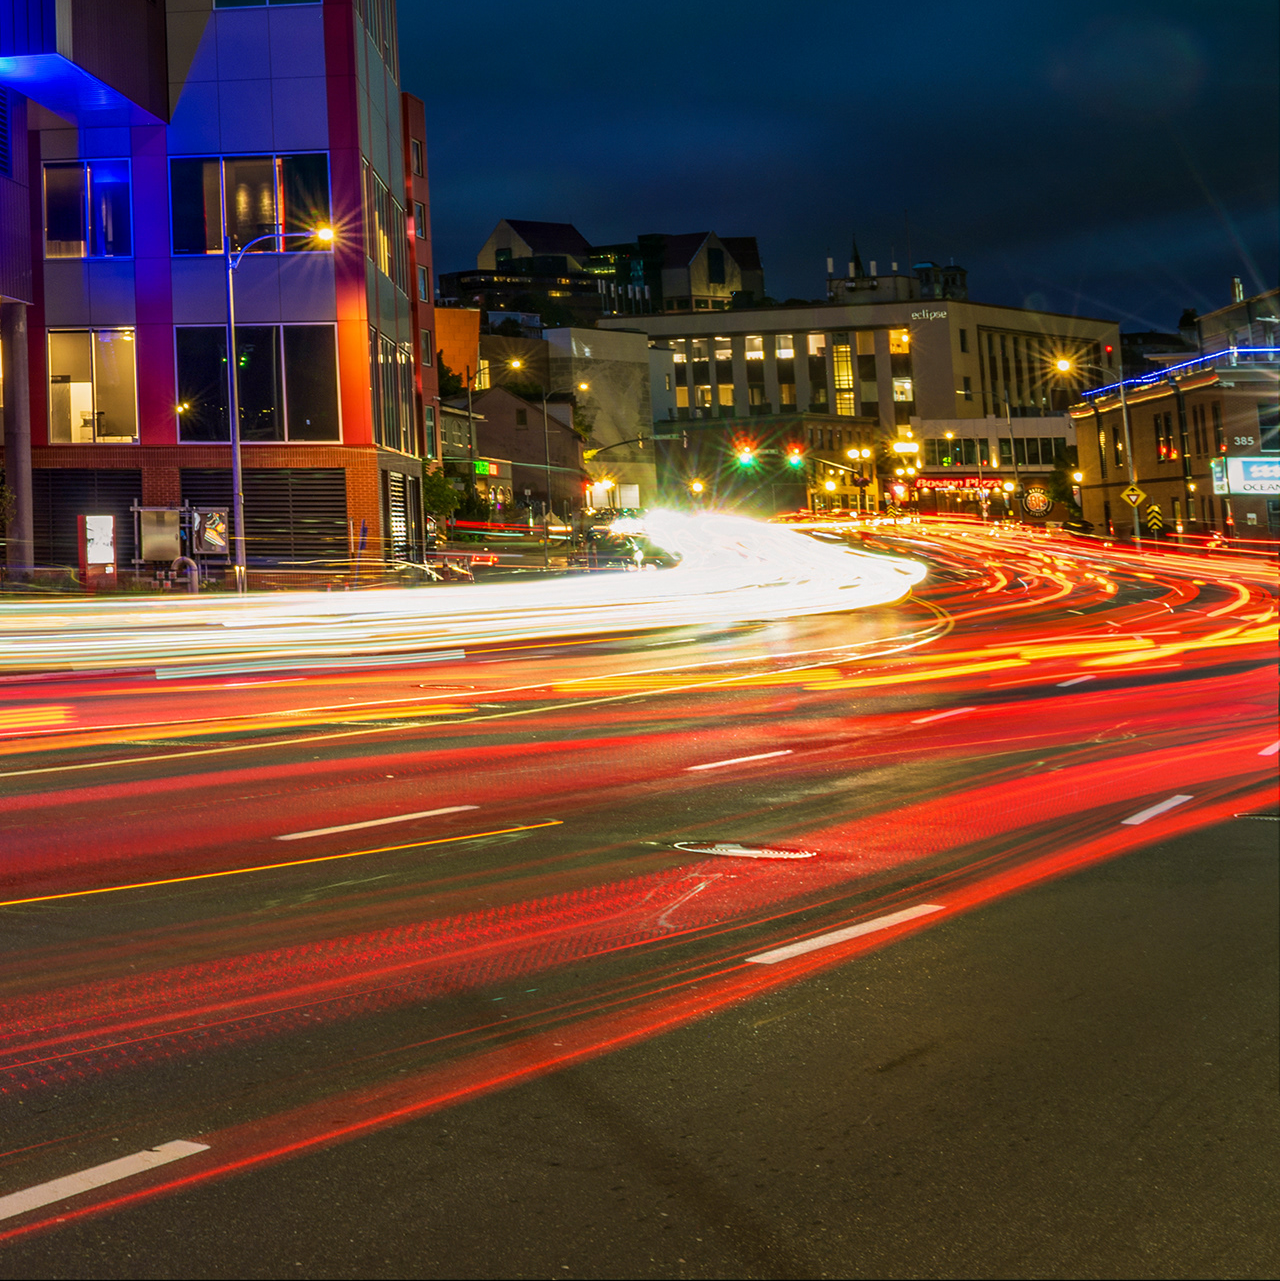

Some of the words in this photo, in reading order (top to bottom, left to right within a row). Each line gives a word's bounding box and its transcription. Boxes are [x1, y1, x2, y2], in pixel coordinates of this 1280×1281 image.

[911, 309, 947, 320] eclipse
[1234, 436, 1255, 446] 385
[916, 478, 963, 488] Boston
[964, 478, 1003, 488] Pizza
